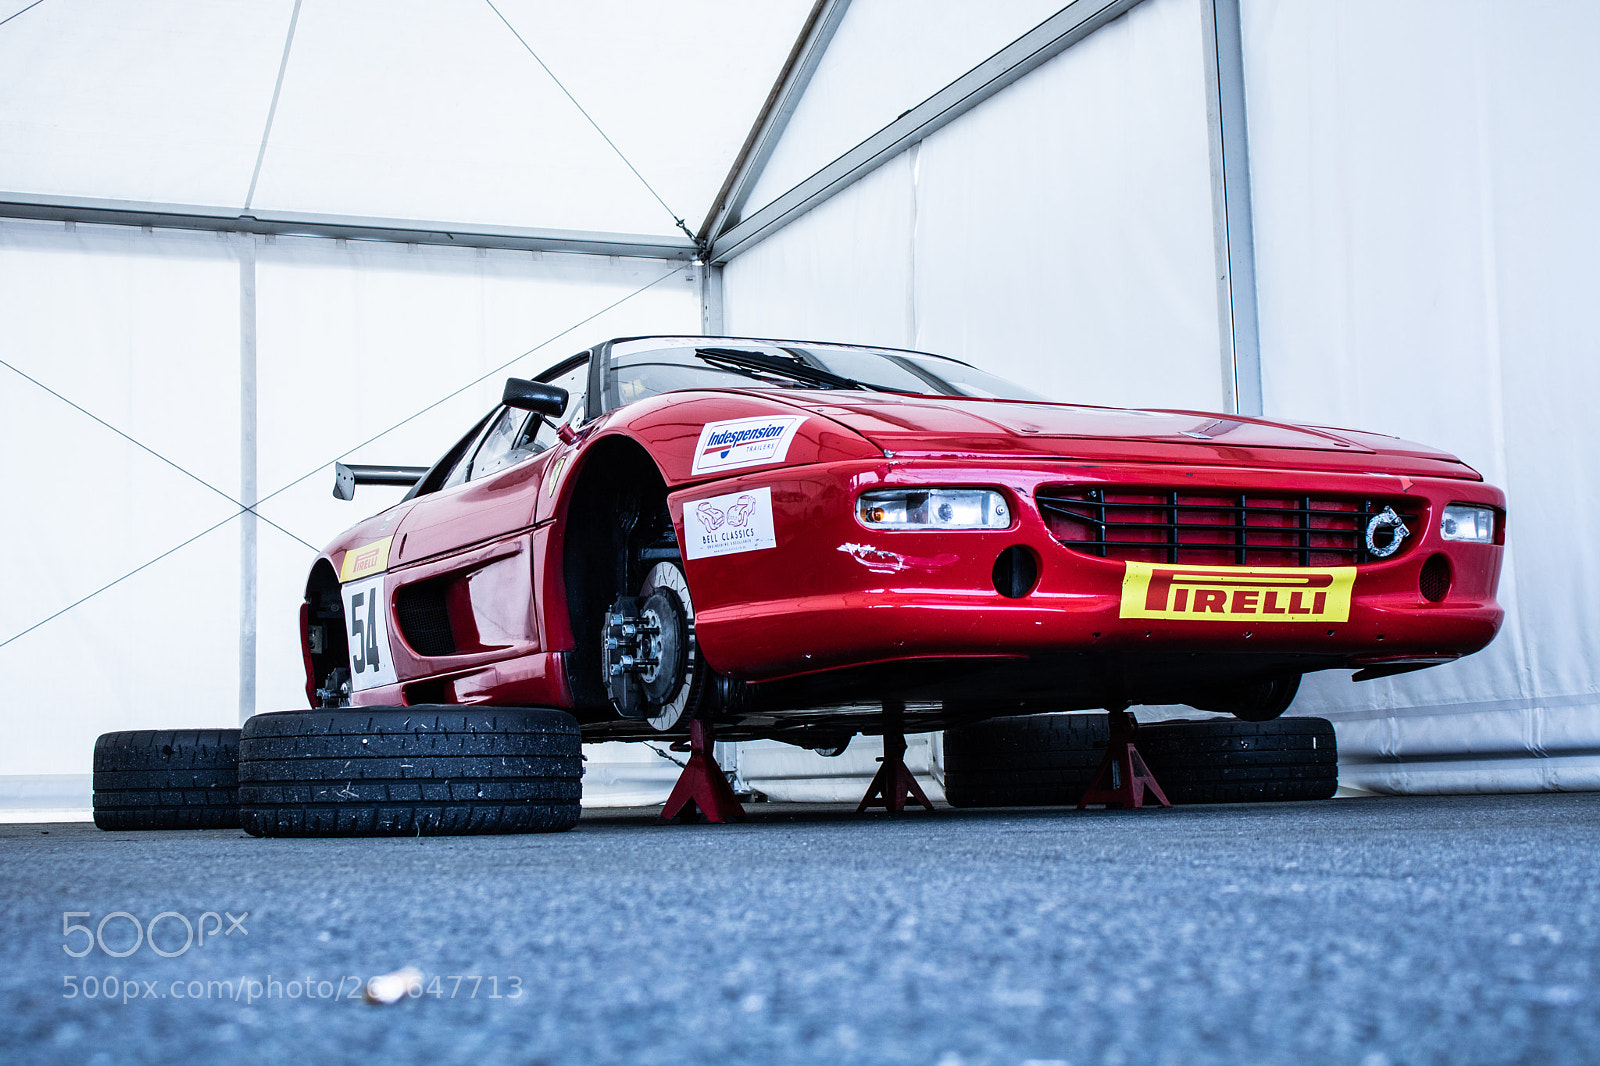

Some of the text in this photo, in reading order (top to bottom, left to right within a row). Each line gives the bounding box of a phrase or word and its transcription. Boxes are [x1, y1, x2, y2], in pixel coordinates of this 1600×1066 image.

[707, 424, 785, 448] Indespension
[746, 443, 775, 453] TRAILERS
[702, 534, 718, 544] BELL
[721, 528, 754, 541] CLASSICS
[353, 548, 380, 573] PIRELLI
[1144, 569, 1334, 615] PIRELLI
[351, 587, 380, 674] 54
